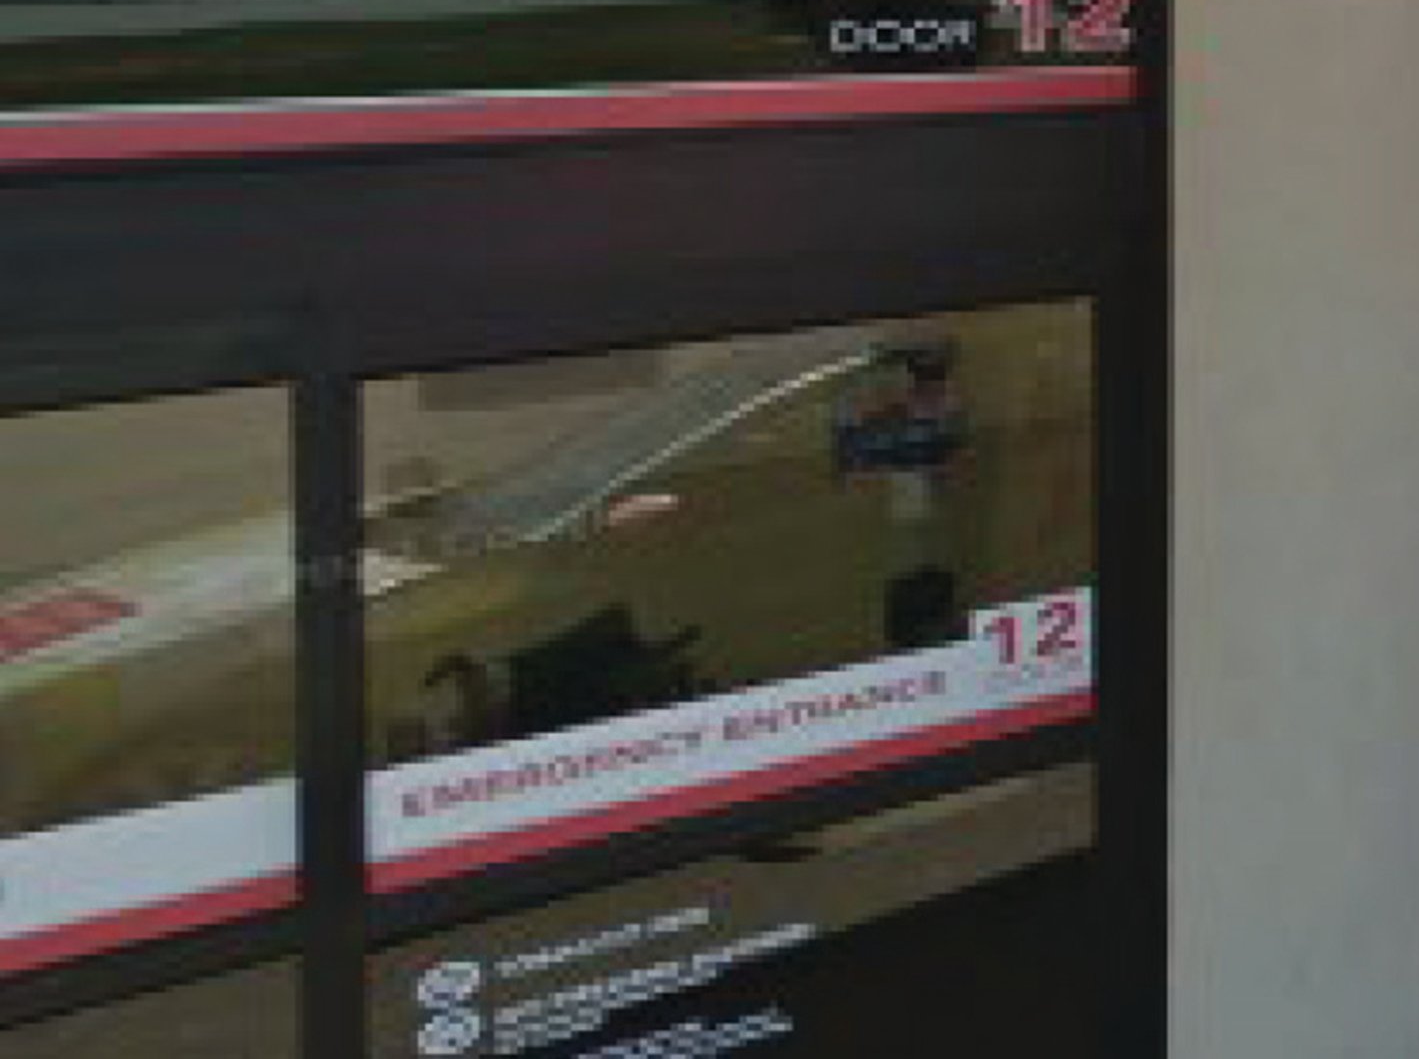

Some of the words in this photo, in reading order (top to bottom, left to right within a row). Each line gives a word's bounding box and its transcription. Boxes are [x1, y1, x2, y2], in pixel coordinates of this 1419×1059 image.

[830, 19, 977, 53] DOOR
[983, 601, 1077, 664] 12
[402, 729, 702, 818] EMERGENCY
[722, 670, 948, 741] ENTRANCE
